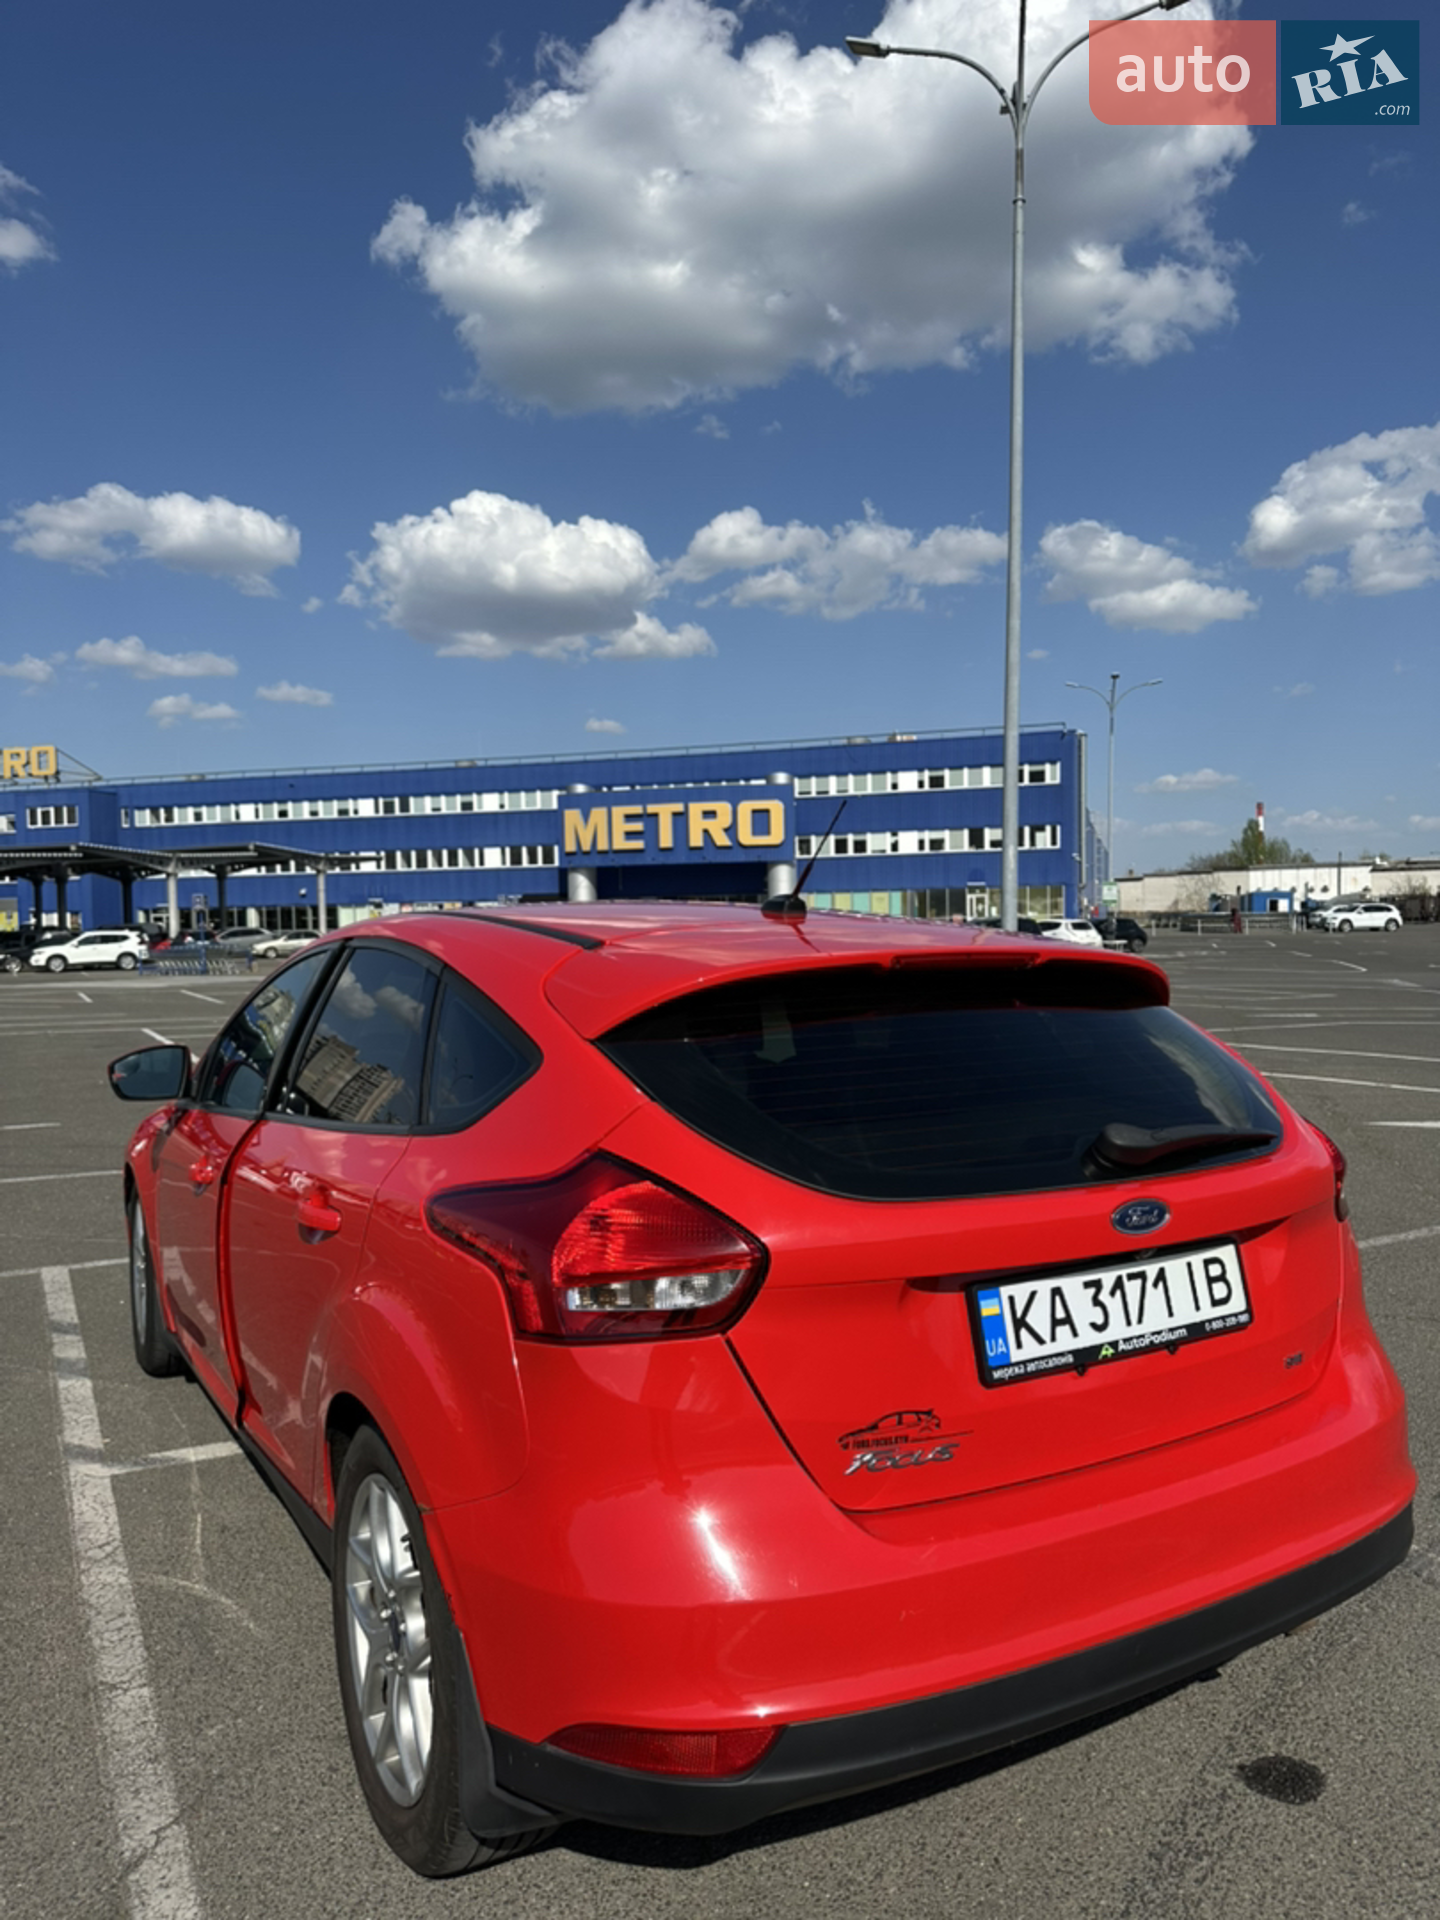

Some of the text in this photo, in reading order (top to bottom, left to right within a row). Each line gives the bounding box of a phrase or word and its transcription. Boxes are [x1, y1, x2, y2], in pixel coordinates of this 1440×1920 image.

[0, 745, 57, 779] RO
[563, 798, 786, 854] METRO
[1125, 1205, 1160, 1226] Ford
[1007, 1256, 1234, 1351] KA 3171 IB
[985, 1338, 1008, 1358] UA
[1118, 1327, 1187, 1352] AutoPodium
